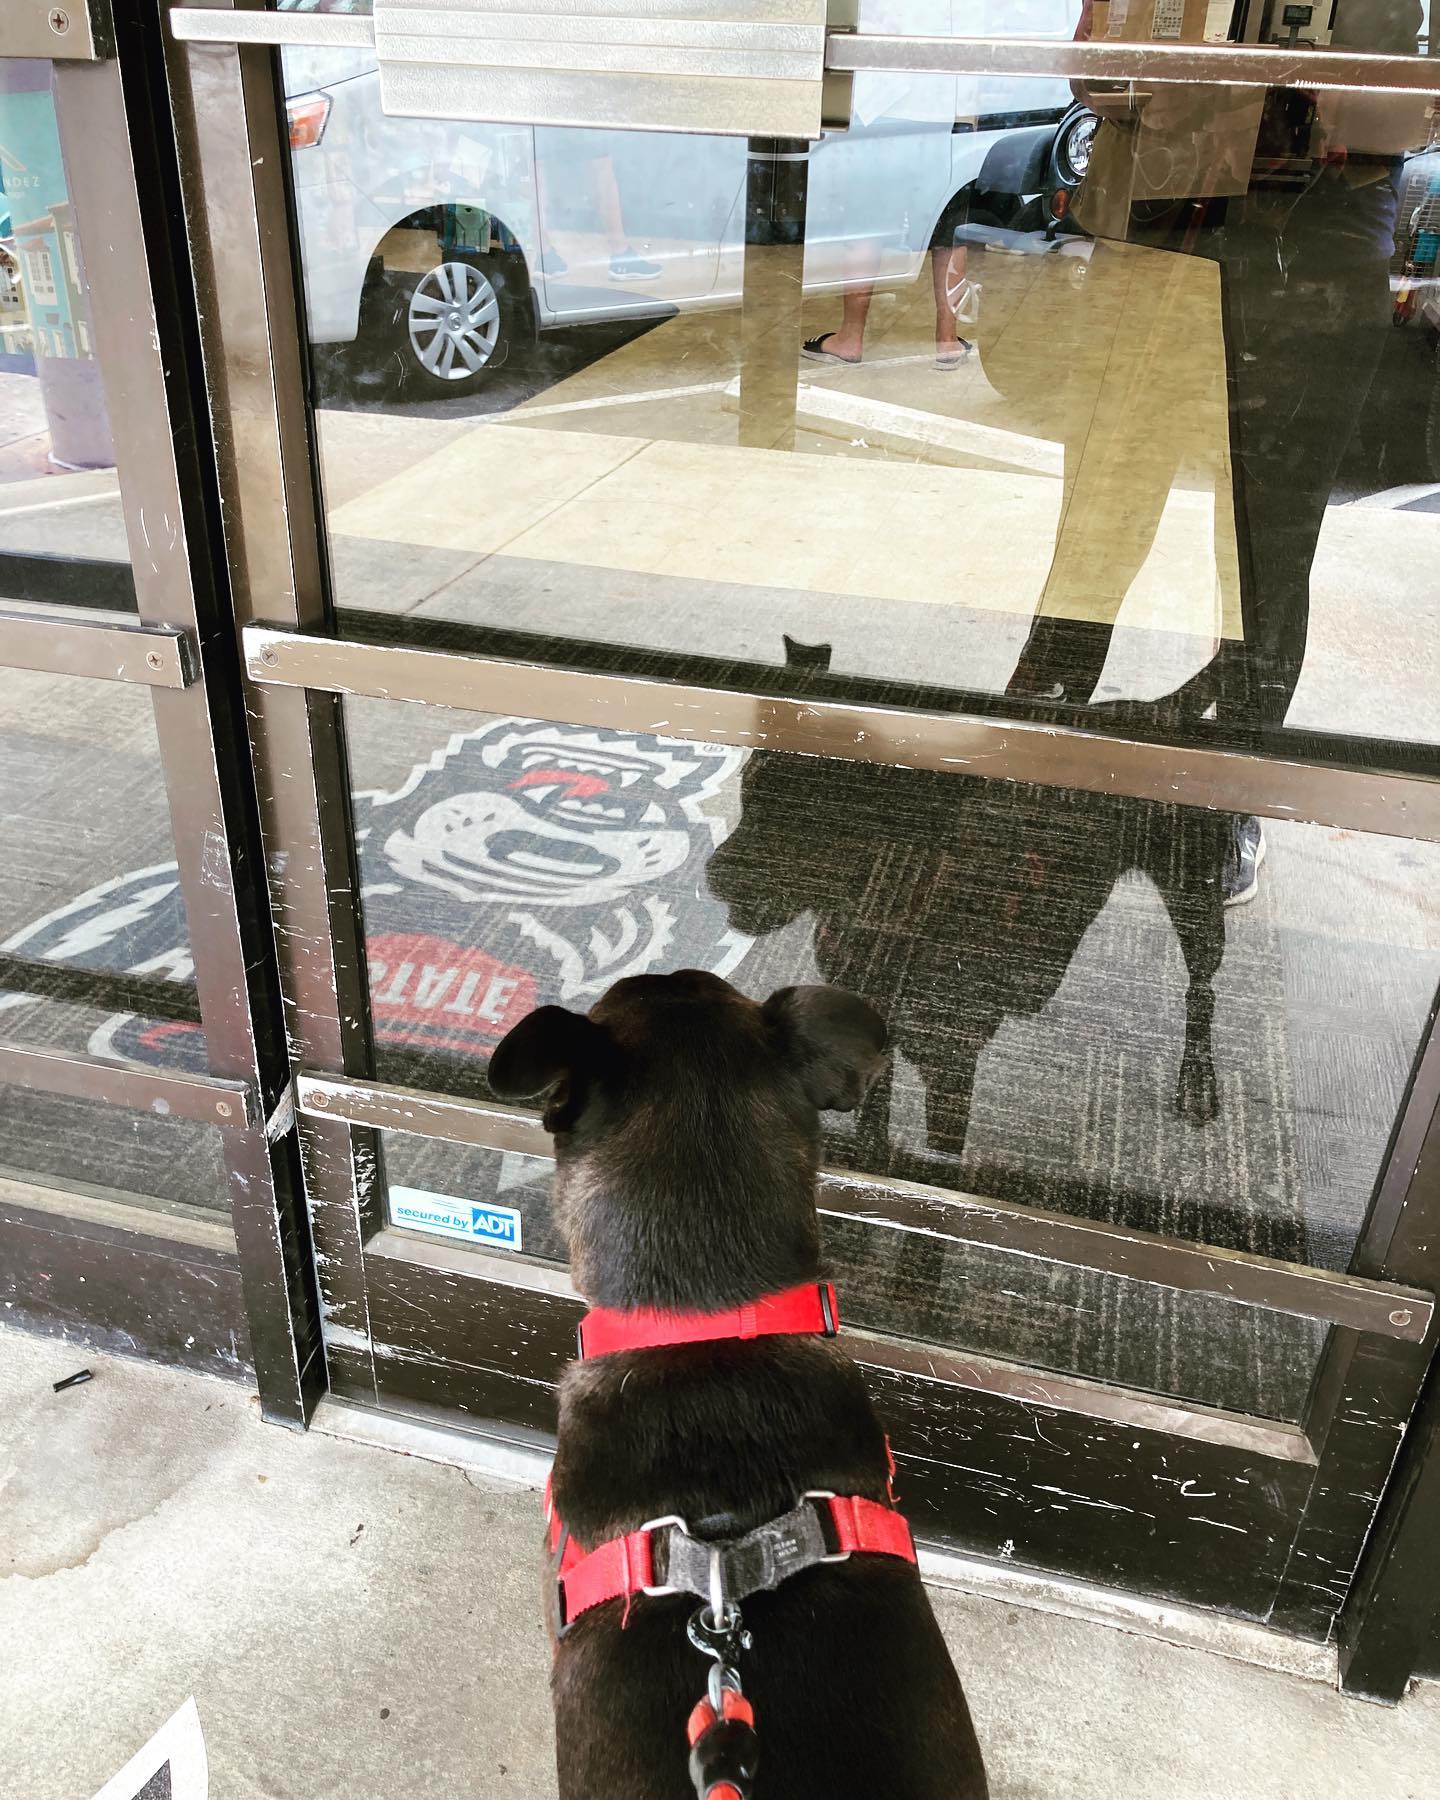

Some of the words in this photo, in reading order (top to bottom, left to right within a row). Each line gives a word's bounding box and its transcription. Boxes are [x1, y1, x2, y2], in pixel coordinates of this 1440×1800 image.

[397, 1207, 450, 1224] secured
[453, 1216, 469, 1229] by
[473, 1213, 514, 1238] ADT
